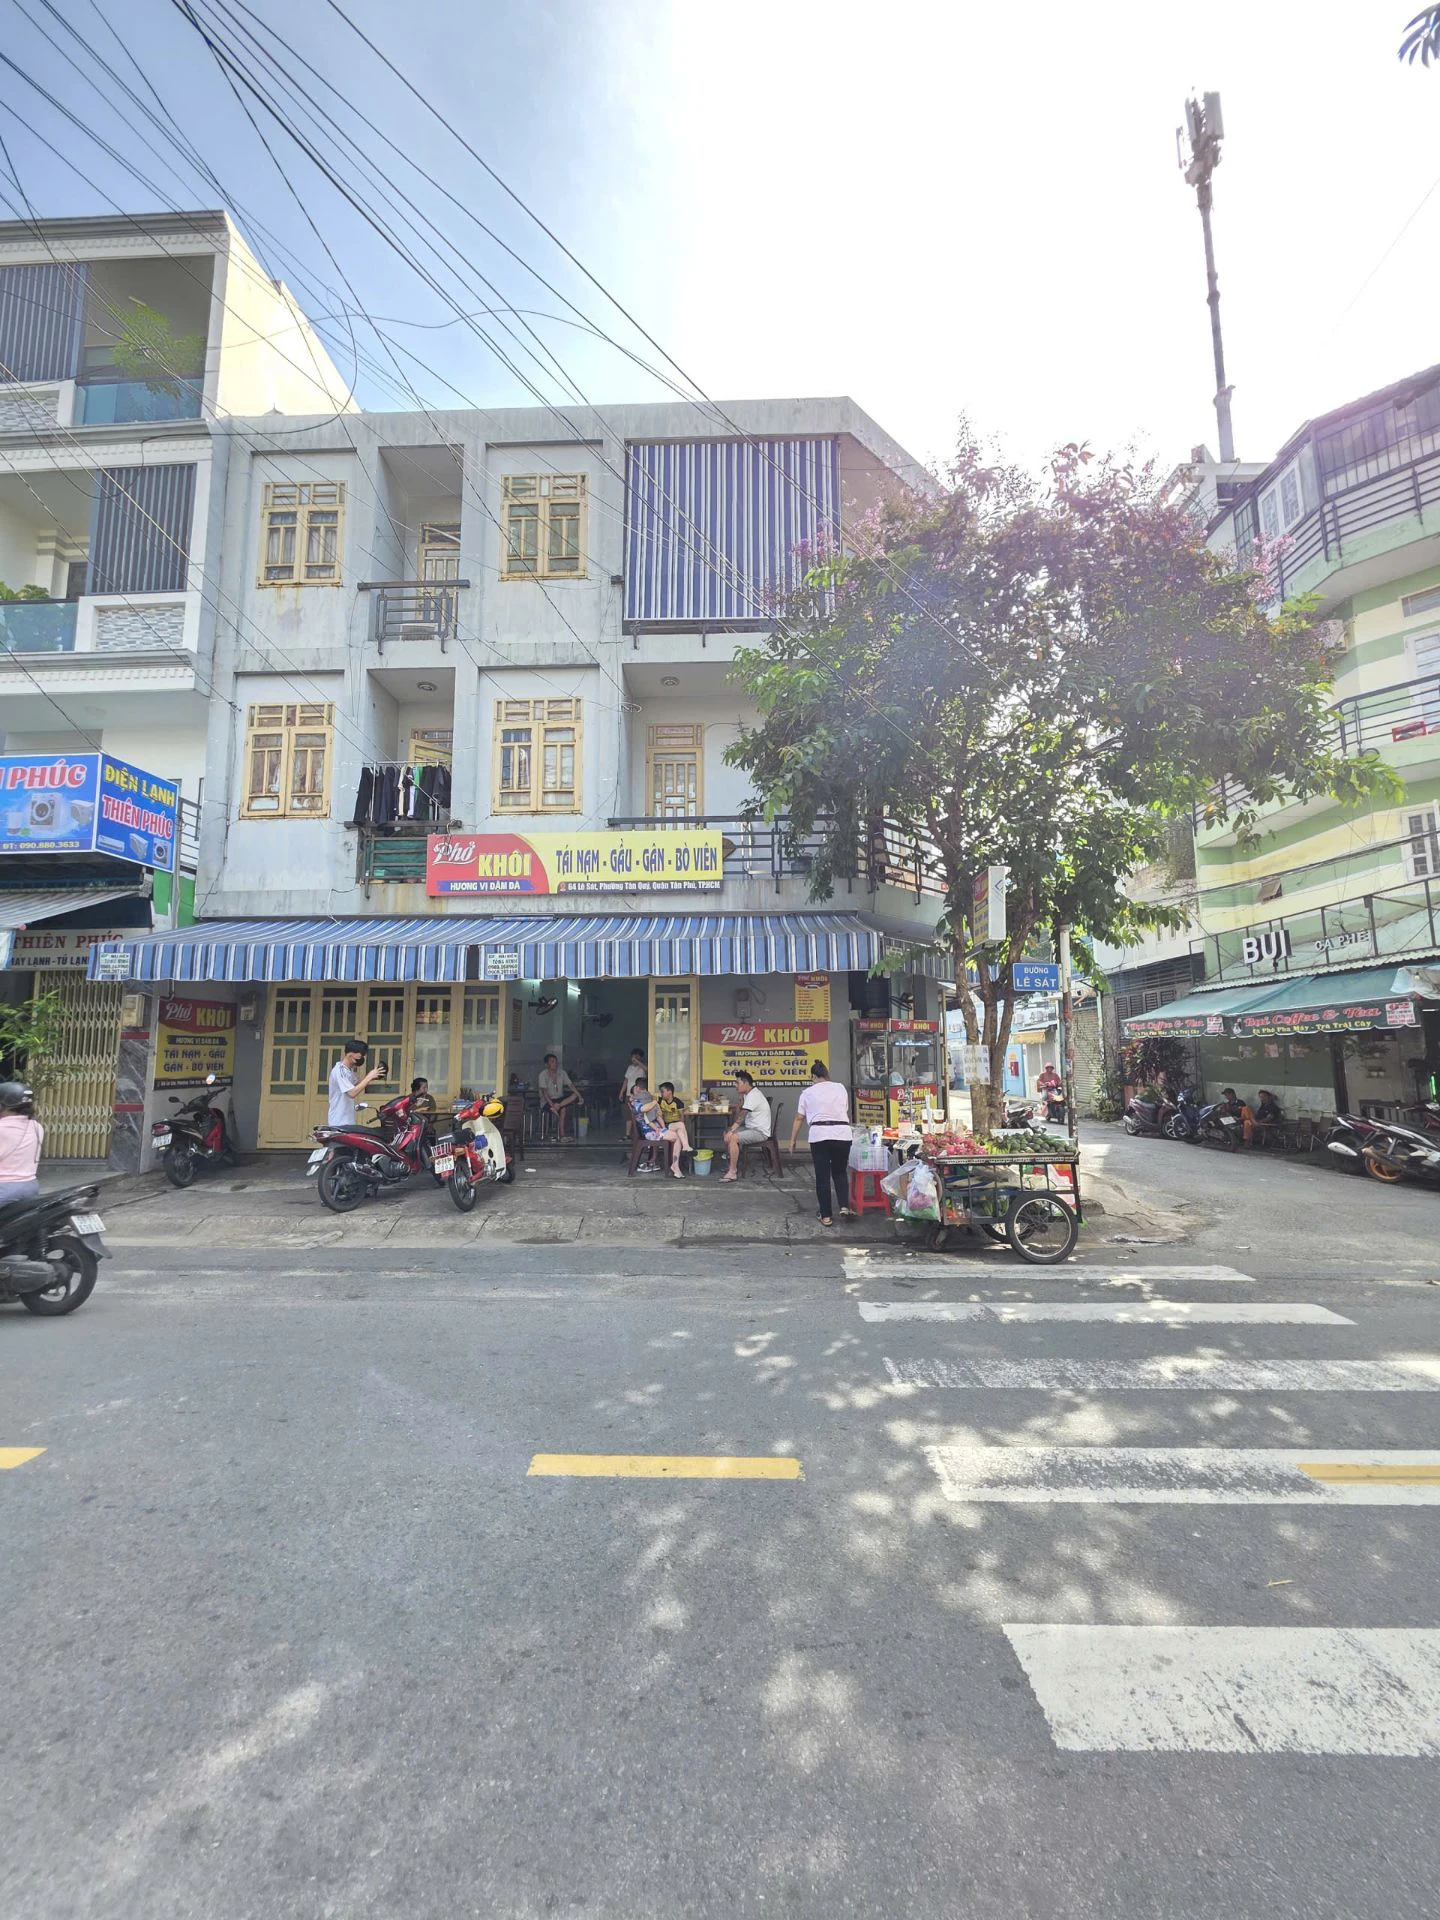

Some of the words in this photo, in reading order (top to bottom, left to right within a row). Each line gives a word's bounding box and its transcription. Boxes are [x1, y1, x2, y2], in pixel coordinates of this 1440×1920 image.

[7, 759, 88, 789] PHÚC
[104, 764, 138, 792] ĐIỆN
[142, 780, 174, 807] LẠNH
[102, 794, 141, 829] THIÊN
[141, 811, 173, 839] PHÚC
[432, 841, 478, 866] Phở
[479, 849, 532, 877] KHÔI
[556, 844, 573, 875] TÁI
[577, 849, 599, 881] NẠM
[675, 842, 690, 872] BÒ
[693, 841, 718, 871] VIÊN
[449, 881, 478, 891] HƯƠNG
[480, 881, 488, 892] VỊ
[13, 933, 67, 949] THIÊN
[71, 956, 89, 967] LẠN
[1016, 976, 1031, 988] LÊ
[1034, 976, 1057, 988] SÁT
[196, 1007, 232, 1028] KHÔI
[721, 1026, 758, 1044] Phở
[764, 1026, 811, 1043] KHÔI
